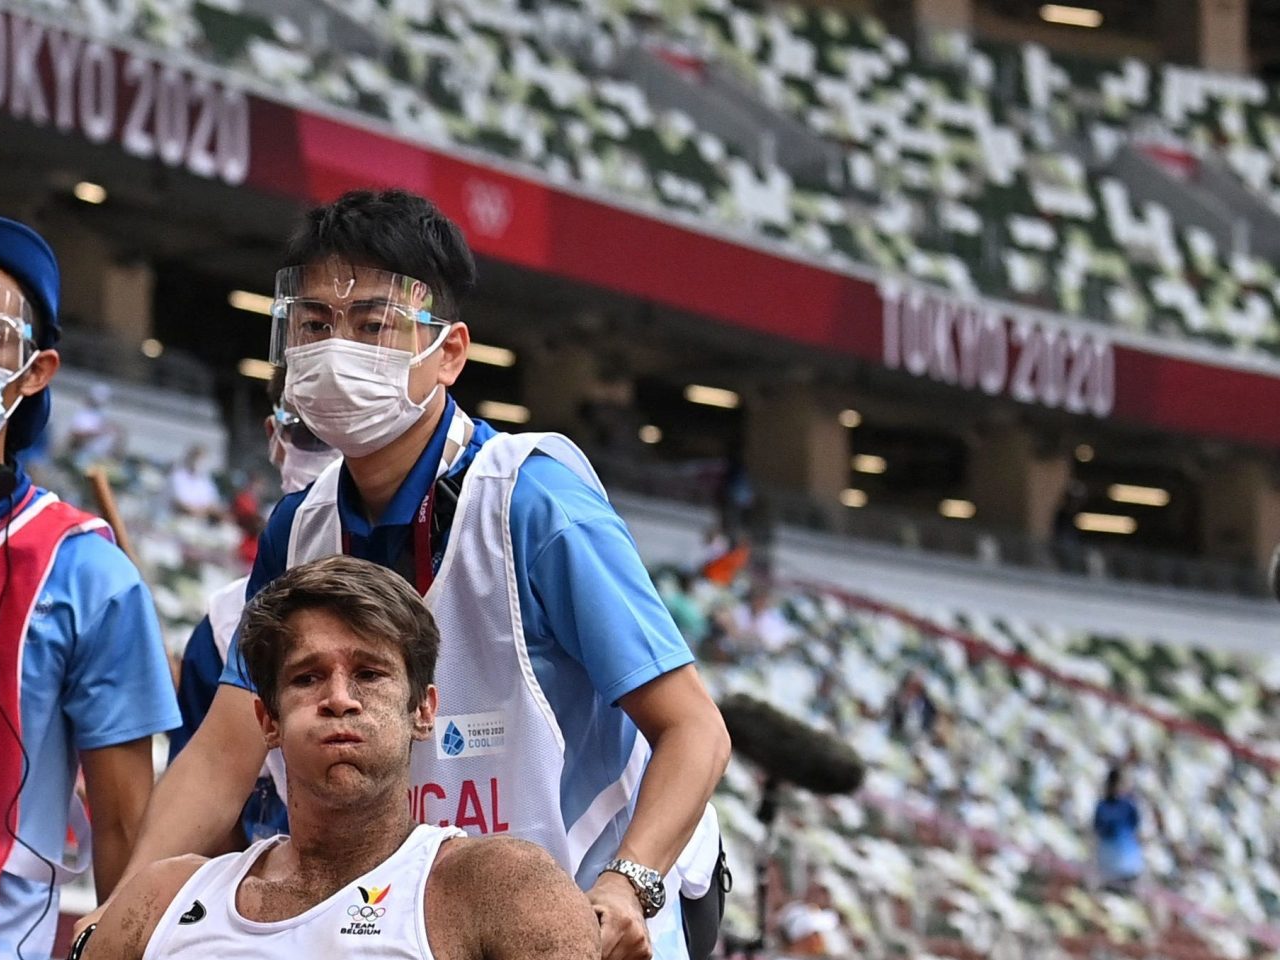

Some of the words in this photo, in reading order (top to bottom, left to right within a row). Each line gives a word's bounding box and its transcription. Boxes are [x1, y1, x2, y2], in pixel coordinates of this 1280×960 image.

[122, 56, 251, 186] 2020
[879, 279, 1008, 396] TOKYO
[1011, 318, 1116, 418] 2020
[468, 728, 490, 737] TOKYO
[407, 777, 509, 833] ICAL
